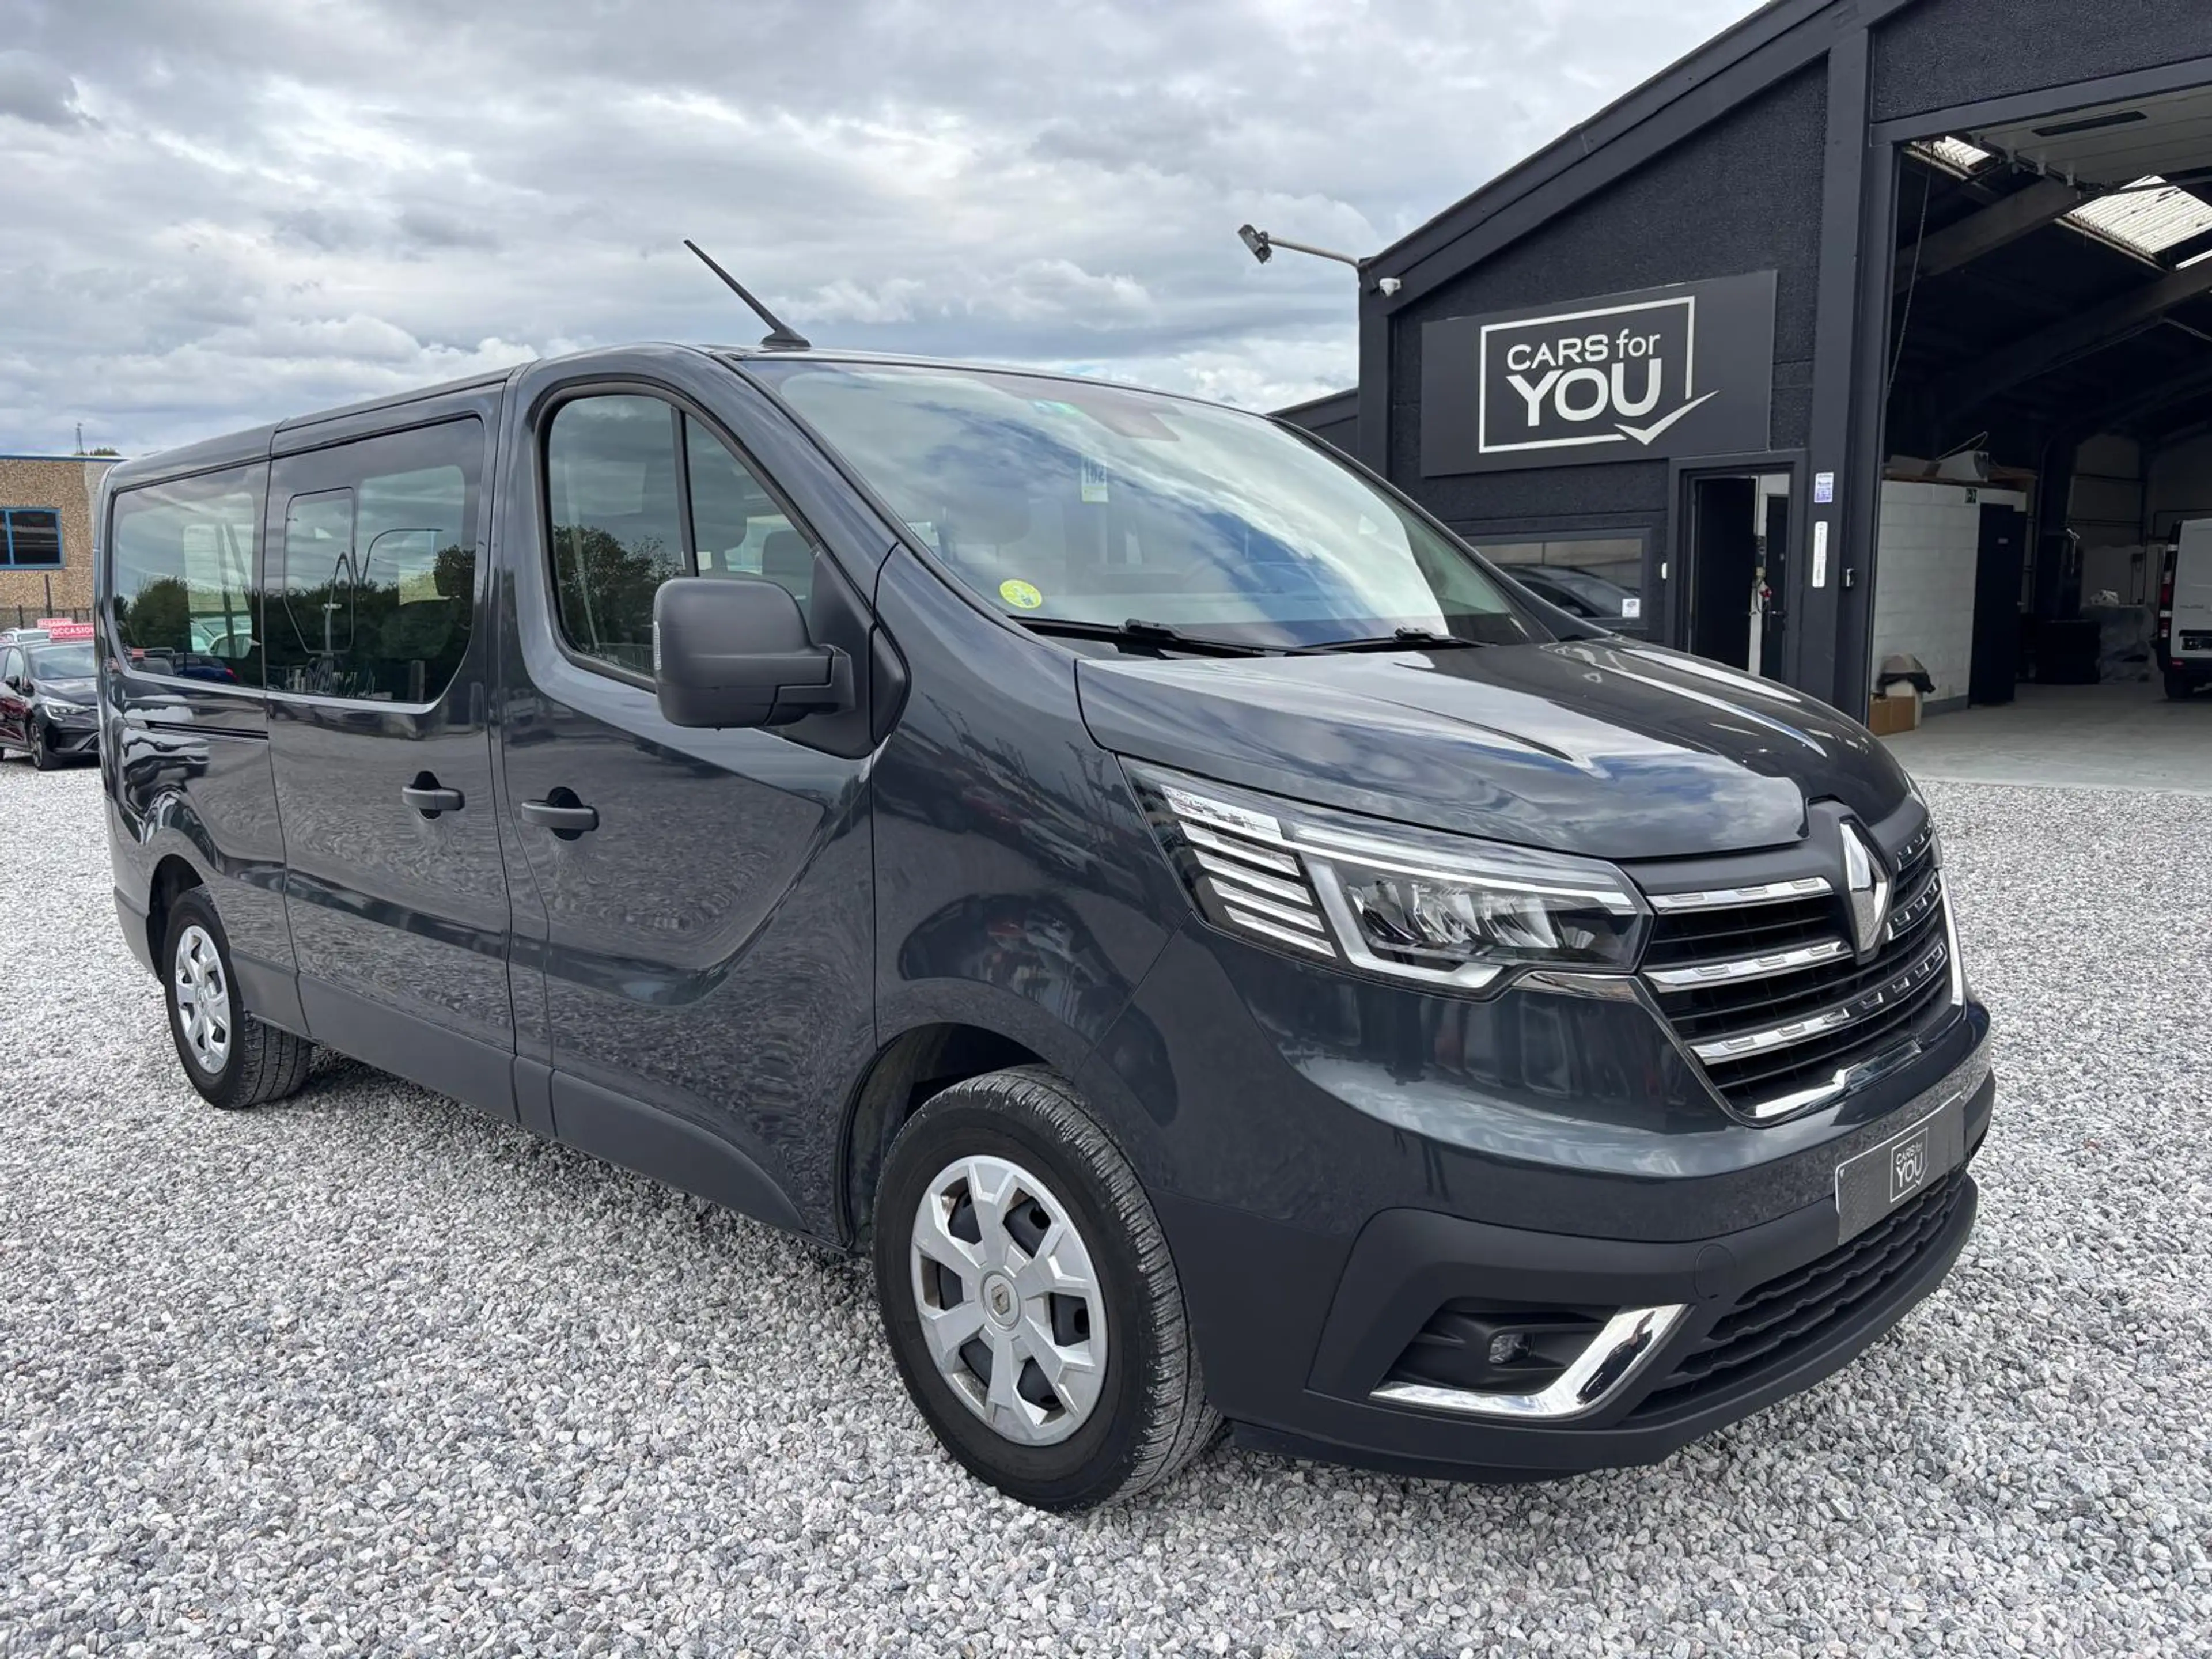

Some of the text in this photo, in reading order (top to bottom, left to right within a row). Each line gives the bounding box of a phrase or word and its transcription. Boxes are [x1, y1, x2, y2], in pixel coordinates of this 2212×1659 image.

[1506, 328, 1661, 372] CARS for
[1505, 358, 1662, 427] YOU
[1896, 1152, 1923, 1188] YOU
